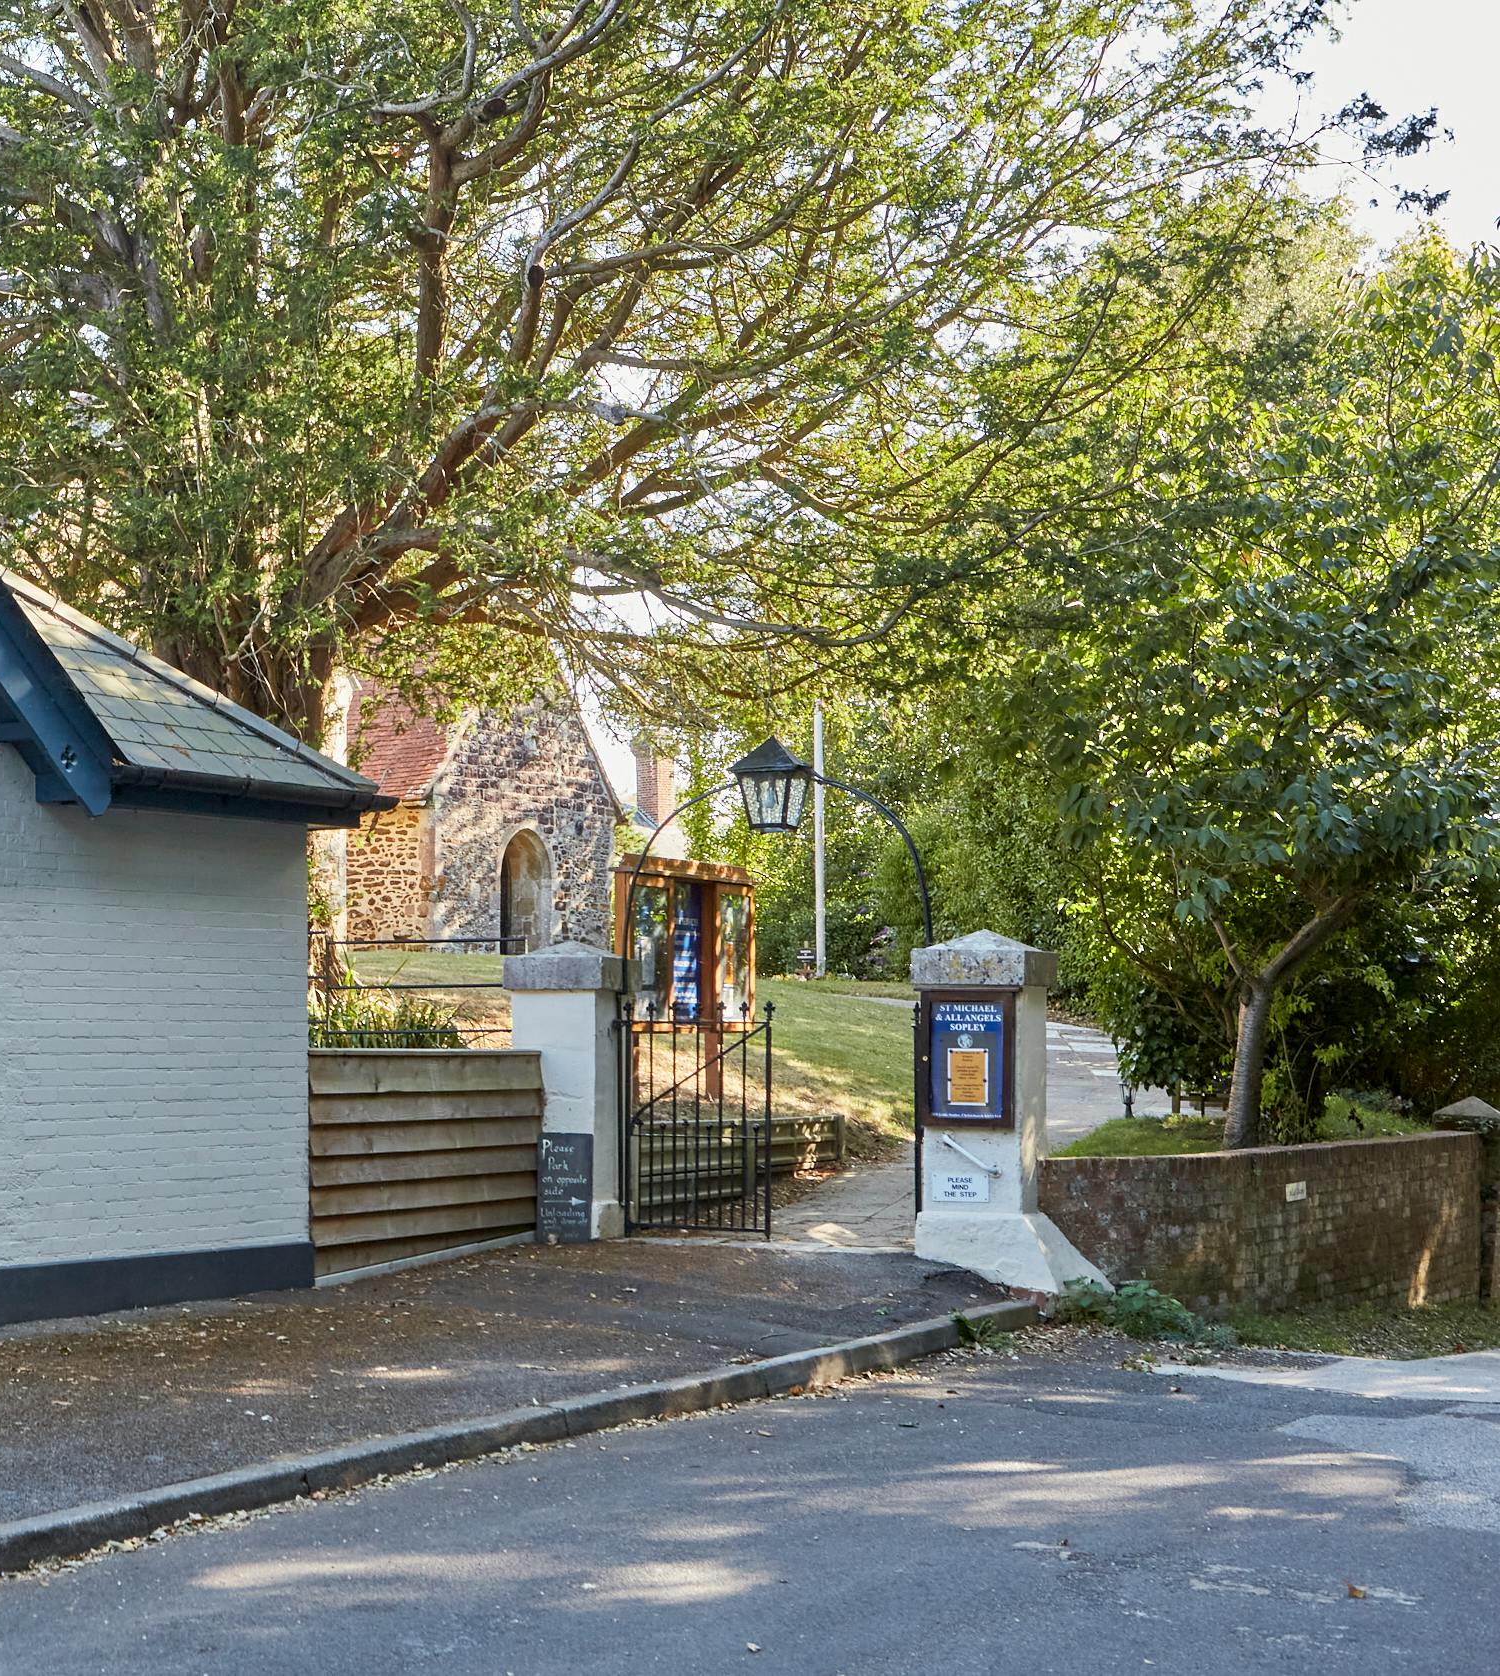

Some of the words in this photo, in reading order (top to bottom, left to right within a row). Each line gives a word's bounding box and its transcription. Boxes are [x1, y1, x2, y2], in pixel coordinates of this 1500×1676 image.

[940, 1004, 952, 1012] ST
[953, 1004, 997, 1013] MICHAEL
[945, 1014, 963, 1022] ALL
[964, 1014, 1002, 1022] ANGELS
[950, 1023, 986, 1032] SOPLEY
[542, 1139, 575, 1160] Please
[548, 1156, 569, 1171] Park
[544, 1186, 564, 1195] side
